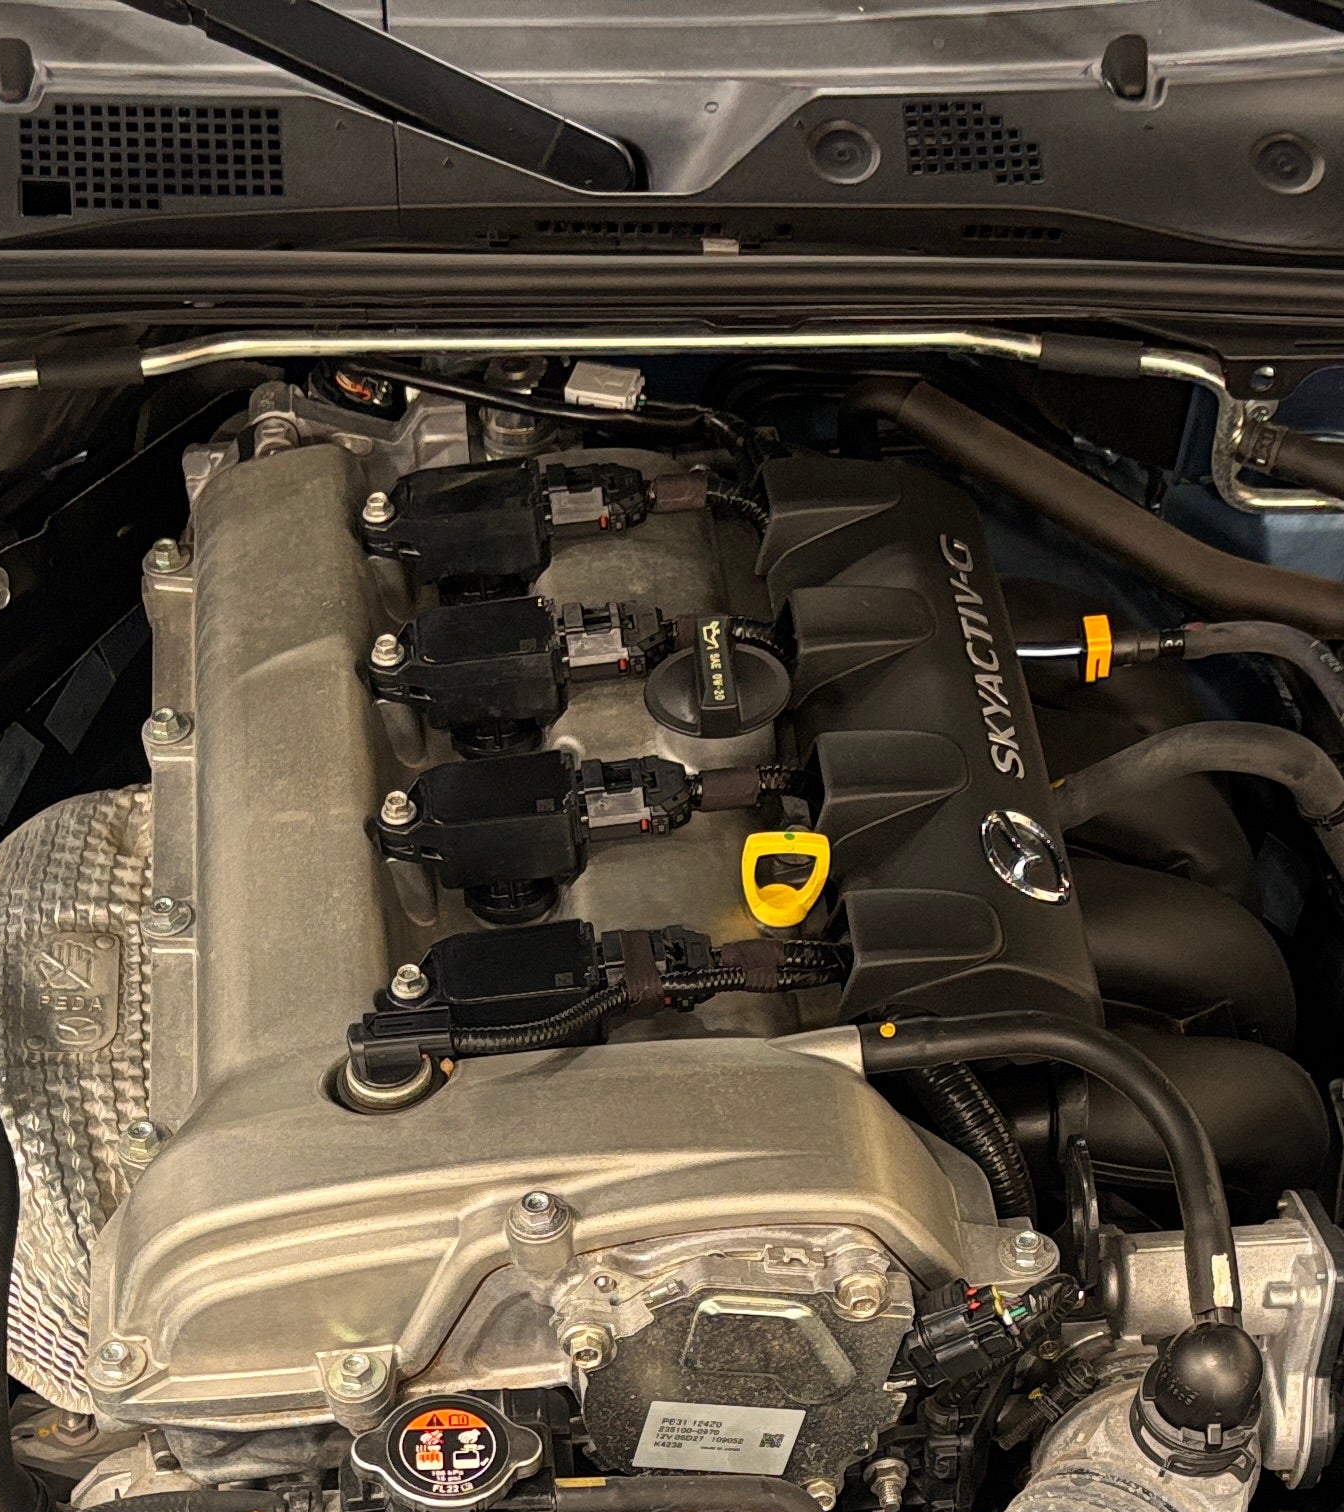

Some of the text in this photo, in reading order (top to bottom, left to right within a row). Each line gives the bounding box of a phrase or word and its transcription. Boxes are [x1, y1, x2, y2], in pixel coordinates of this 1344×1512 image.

[940, 533, 1026, 780] SKYACTIV-G
[709, 653, 725, 701] SAE 0W-20
[38, 995, 103, 1011] PEDA
[432, 1484, 459, 1493] FL22
